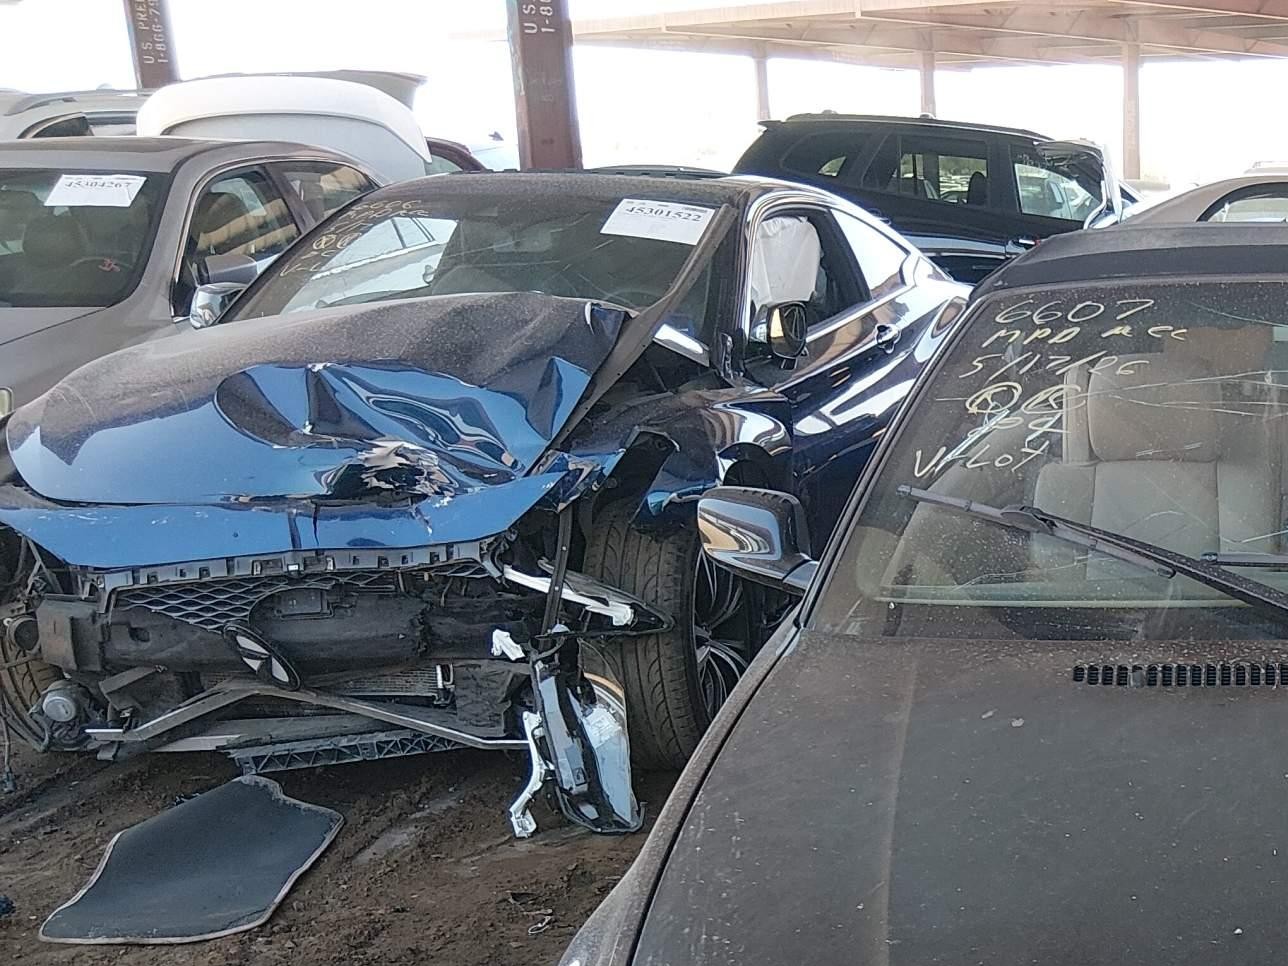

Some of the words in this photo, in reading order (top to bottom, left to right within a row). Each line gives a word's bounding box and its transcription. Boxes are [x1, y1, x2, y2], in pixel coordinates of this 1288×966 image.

[136, 0, 150, 30] PRE
[540, 0, 556, 33] 1-8
[626, 206, 702, 222] 45301522
[995, 299, 1154, 325] 6607
